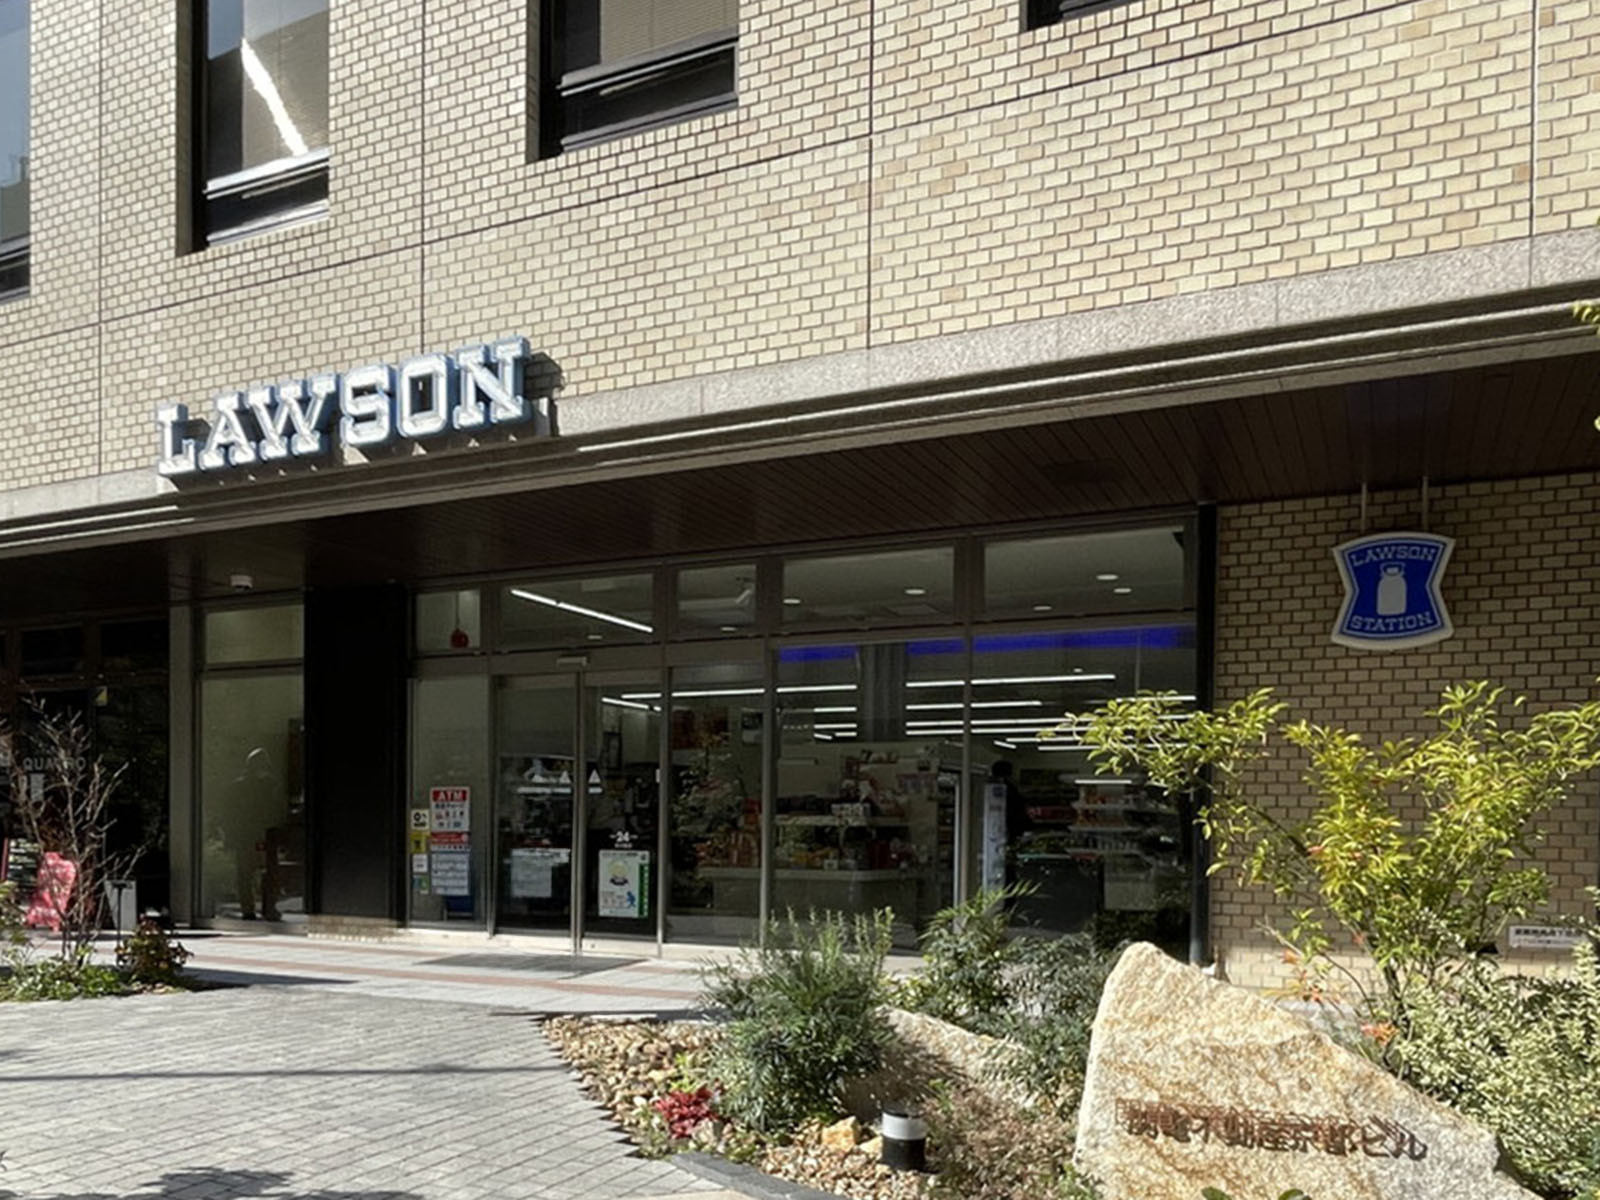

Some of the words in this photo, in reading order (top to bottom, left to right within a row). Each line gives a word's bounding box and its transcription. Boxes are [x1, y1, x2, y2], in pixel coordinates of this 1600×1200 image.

[158, 336, 530, 476] LAWSON
[1351, 546, 1436, 566] LAWSON
[1351, 612, 1434, 631] STATION
[437, 790, 464, 802] ATM
